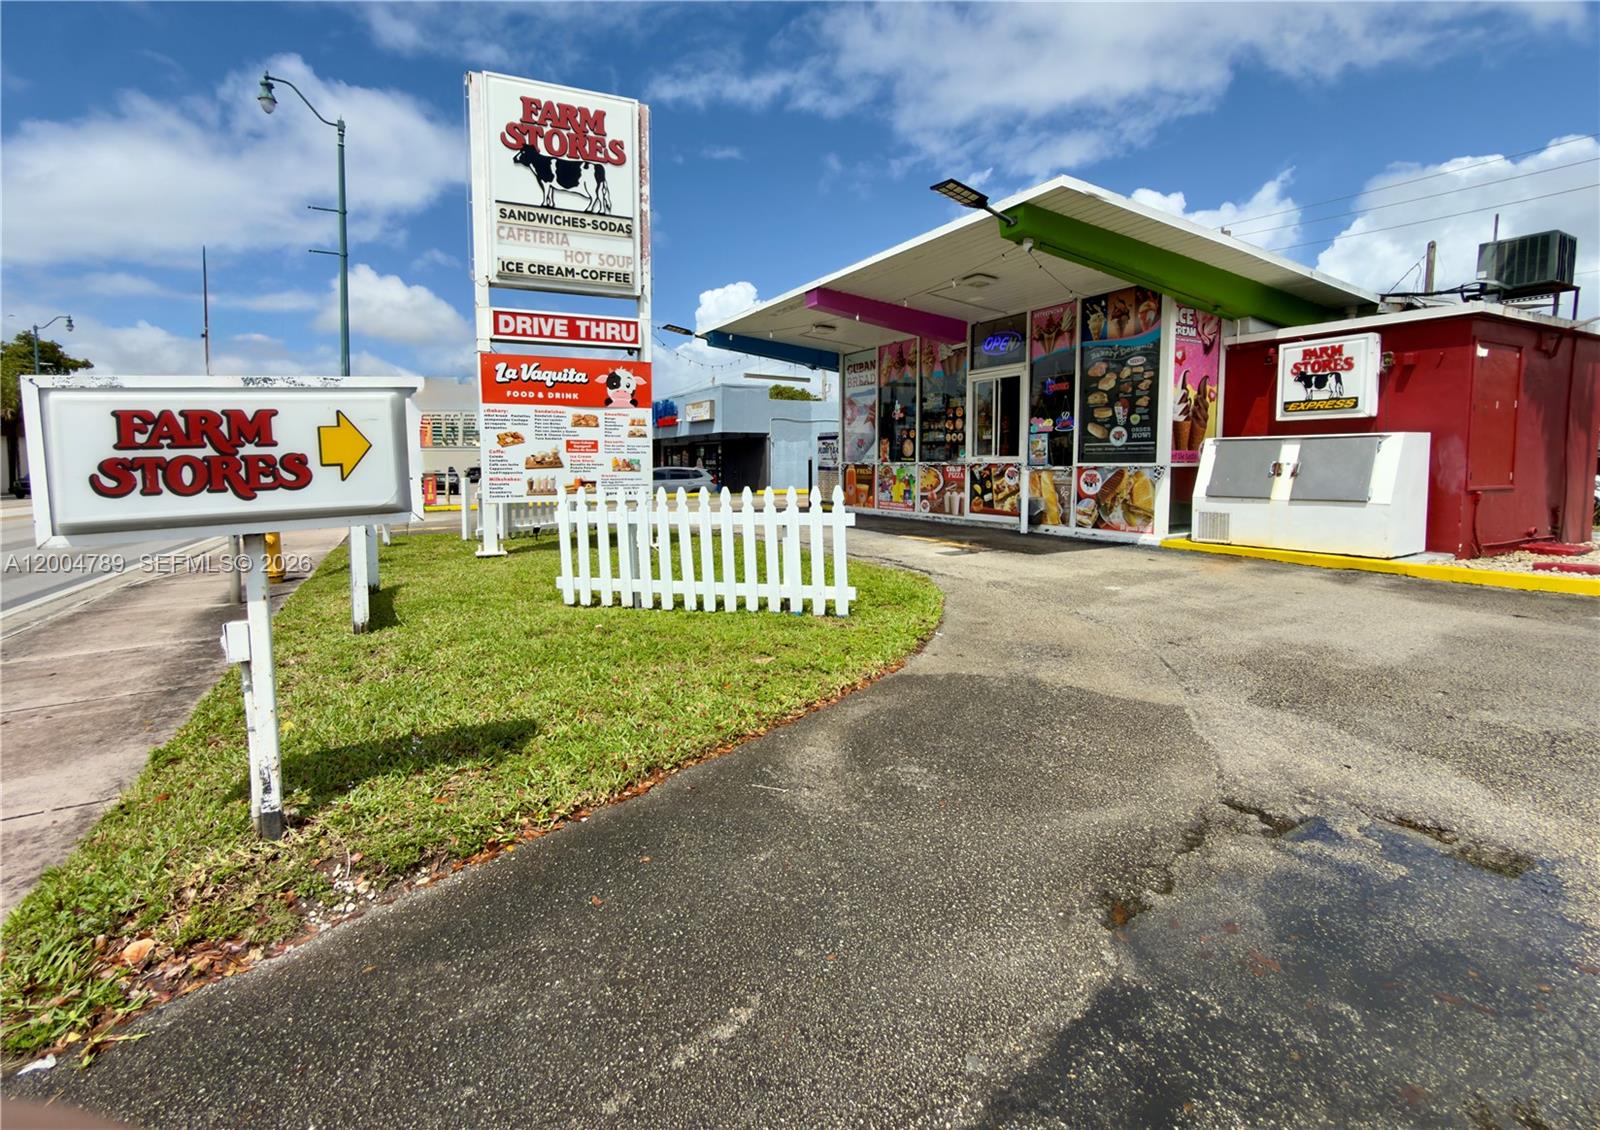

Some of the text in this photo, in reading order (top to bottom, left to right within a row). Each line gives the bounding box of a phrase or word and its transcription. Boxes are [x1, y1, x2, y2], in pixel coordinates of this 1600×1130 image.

[520, 96, 606, 136] FARM
[500, 122, 626, 166] STORES
[499, 208, 632, 234] SANDWICHES-SODAS
[497, 226, 570, 246] CAFETERIA
[564, 250, 632, 269] HOT SOUP
[501, 260, 630, 283] ICE CREAM-COFFEE
[498, 314, 636, 342] DRIVE THRU
[984, 336, 1017, 352] OPEN
[1302, 344, 1344, 361] FARM
[495, 362, 590, 388] La Vaquita
[847, 360, 876, 374] CUBAN
[1290, 356, 1354, 376] STORES
[847, 374, 876, 388] BREAD
[506, 390, 535, 398] FOOD
[1287, 398, 1356, 410] EXPRESS
[110, 408, 278, 456] FARM
[88, 452, 313, 501] STORES
